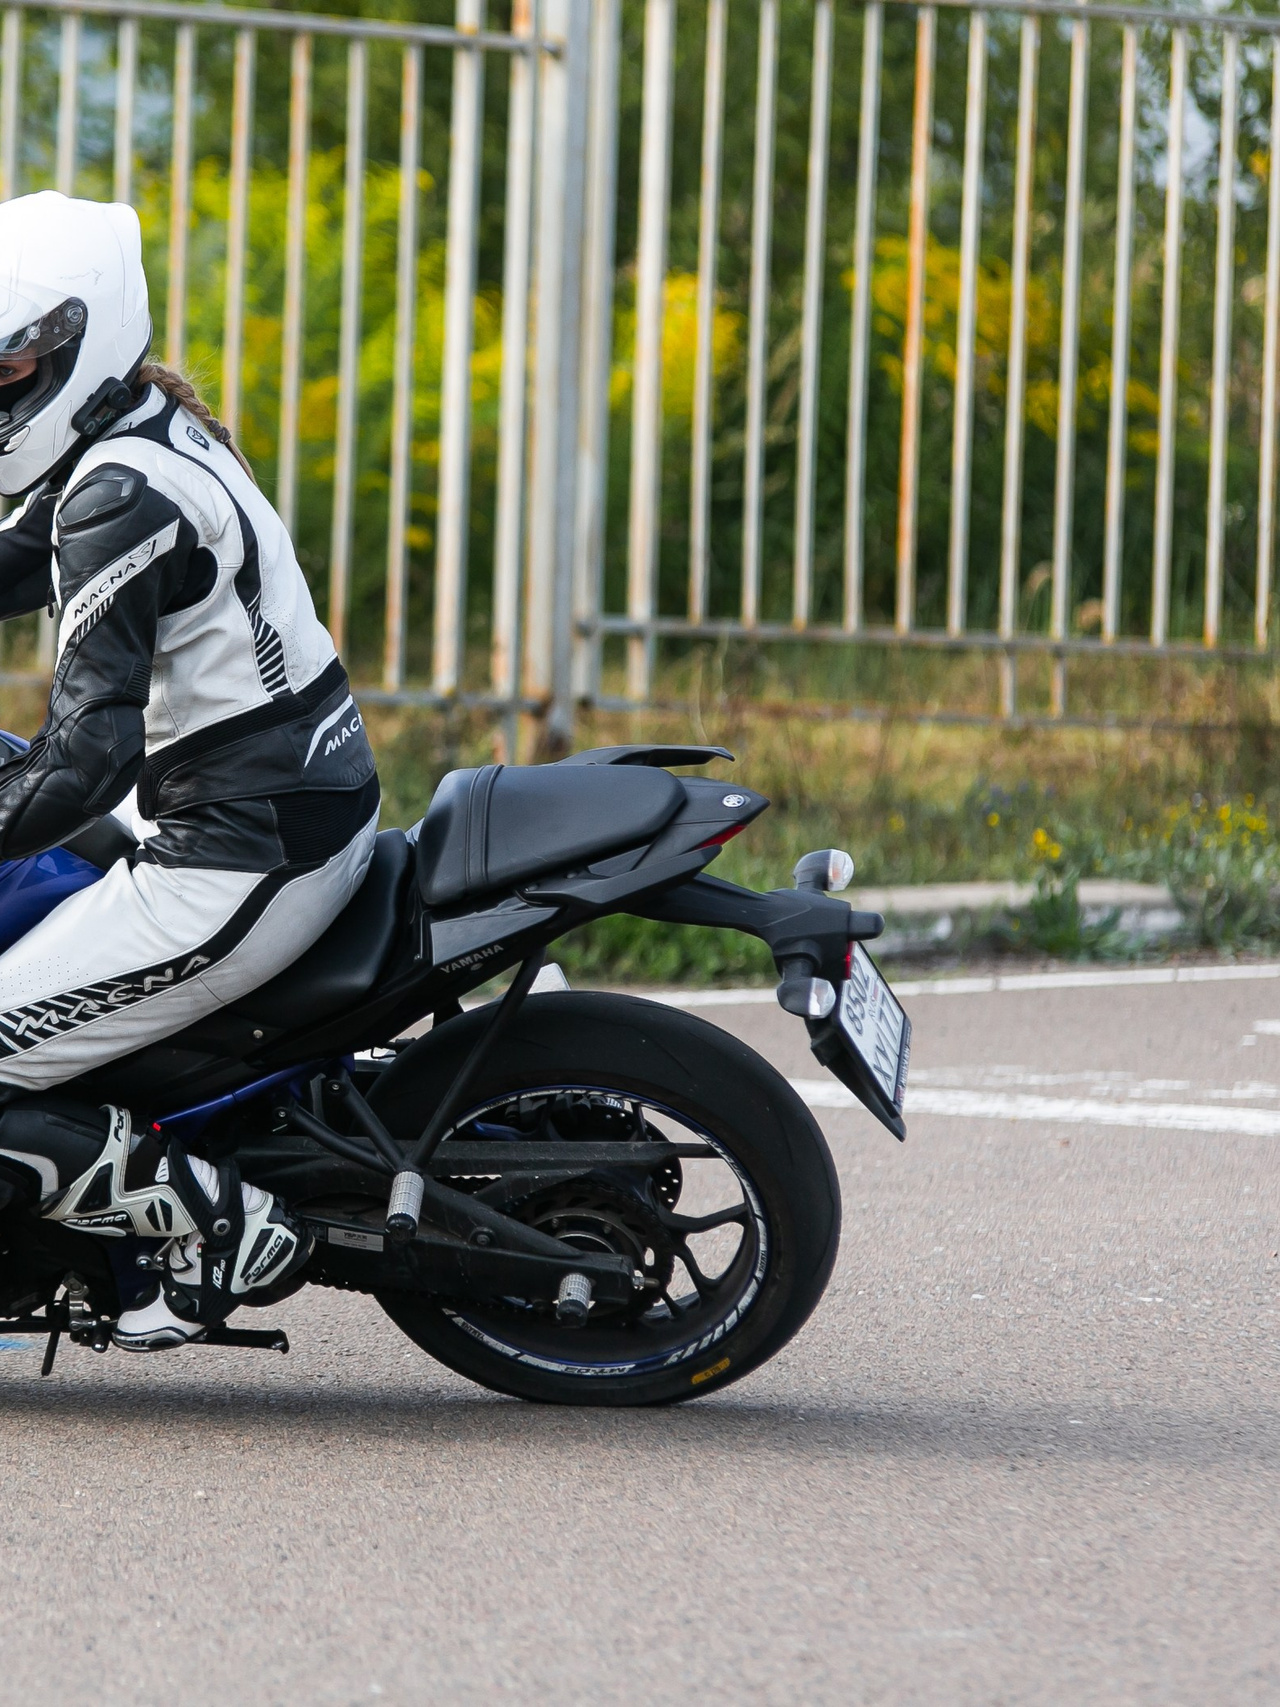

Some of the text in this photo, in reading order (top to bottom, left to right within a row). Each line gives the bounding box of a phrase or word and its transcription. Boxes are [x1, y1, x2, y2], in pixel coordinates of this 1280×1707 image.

[74, 562, 137, 619] MACNA
[440, 944, 504, 974] YAMAHA
[16, 954, 211, 1036] MACNA
[845, 955, 871, 1036] 8502
